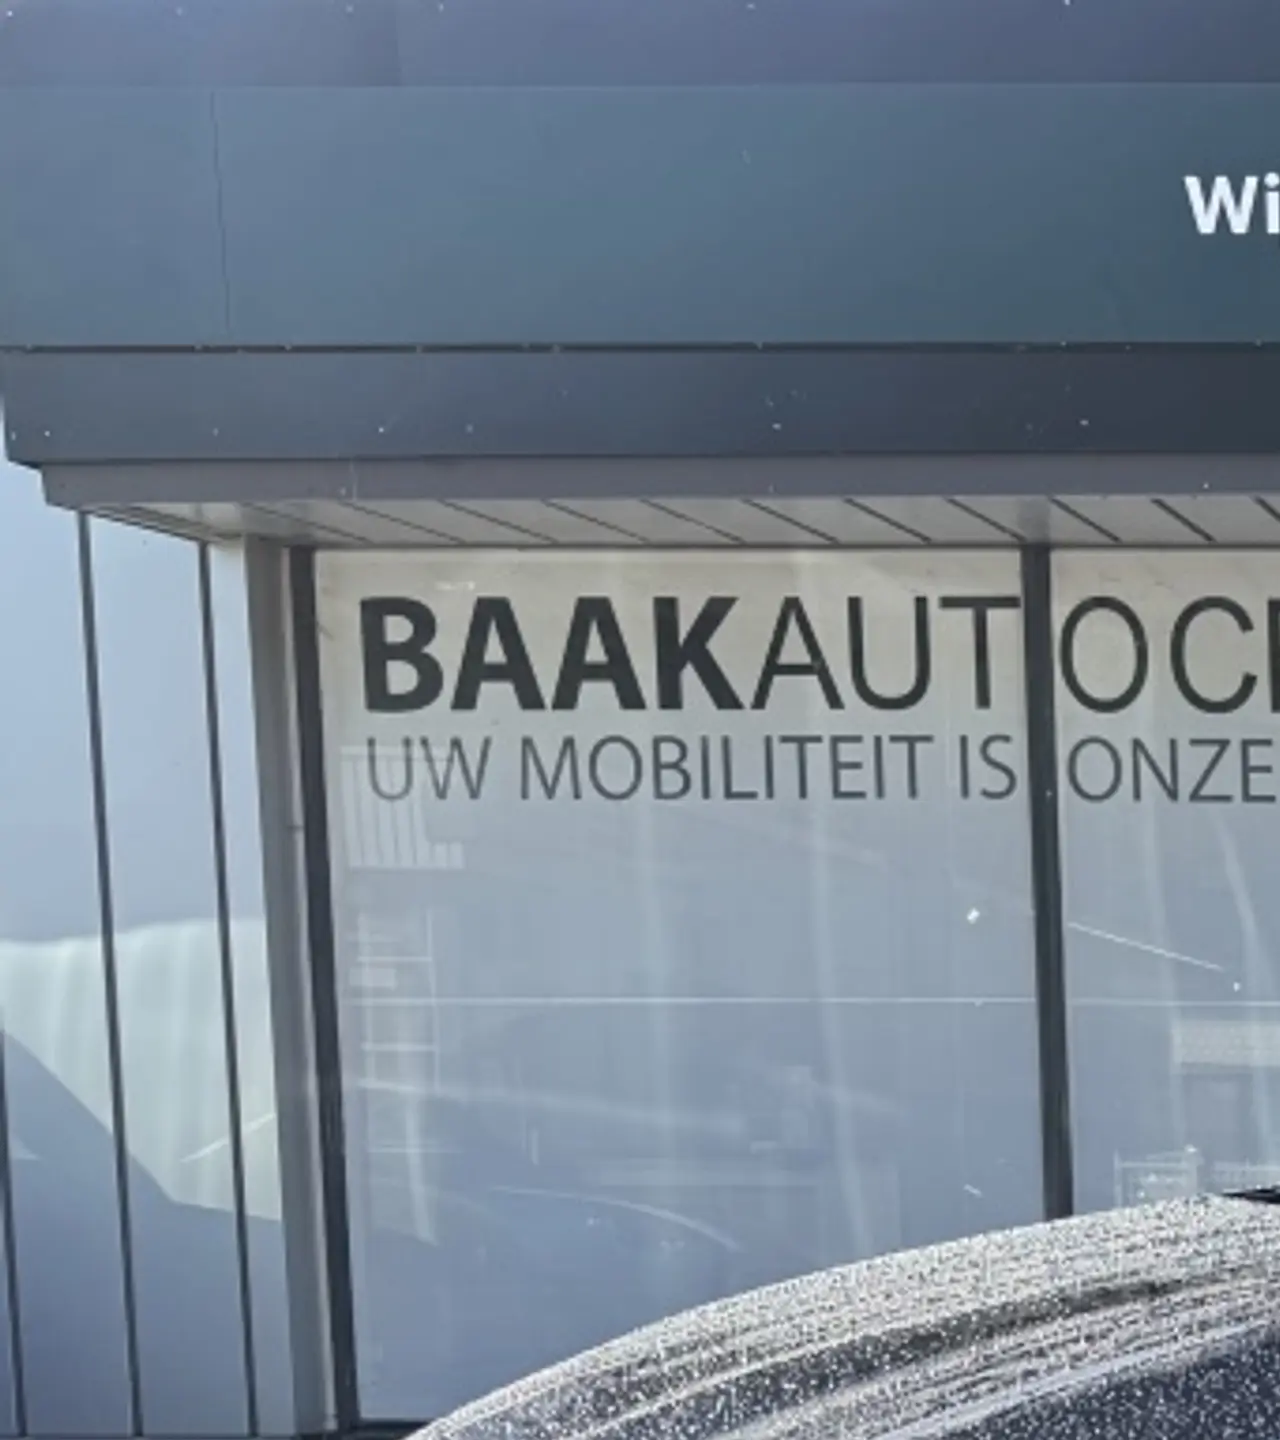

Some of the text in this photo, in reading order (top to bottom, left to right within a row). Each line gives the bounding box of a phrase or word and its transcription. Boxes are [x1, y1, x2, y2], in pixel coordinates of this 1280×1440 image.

[365, 735, 493, 801] UW
[519, 734, 935, 801] MOBILITEIT
[959, 734, 1018, 800] IS
[1066, 735, 1278, 804] ONZE
